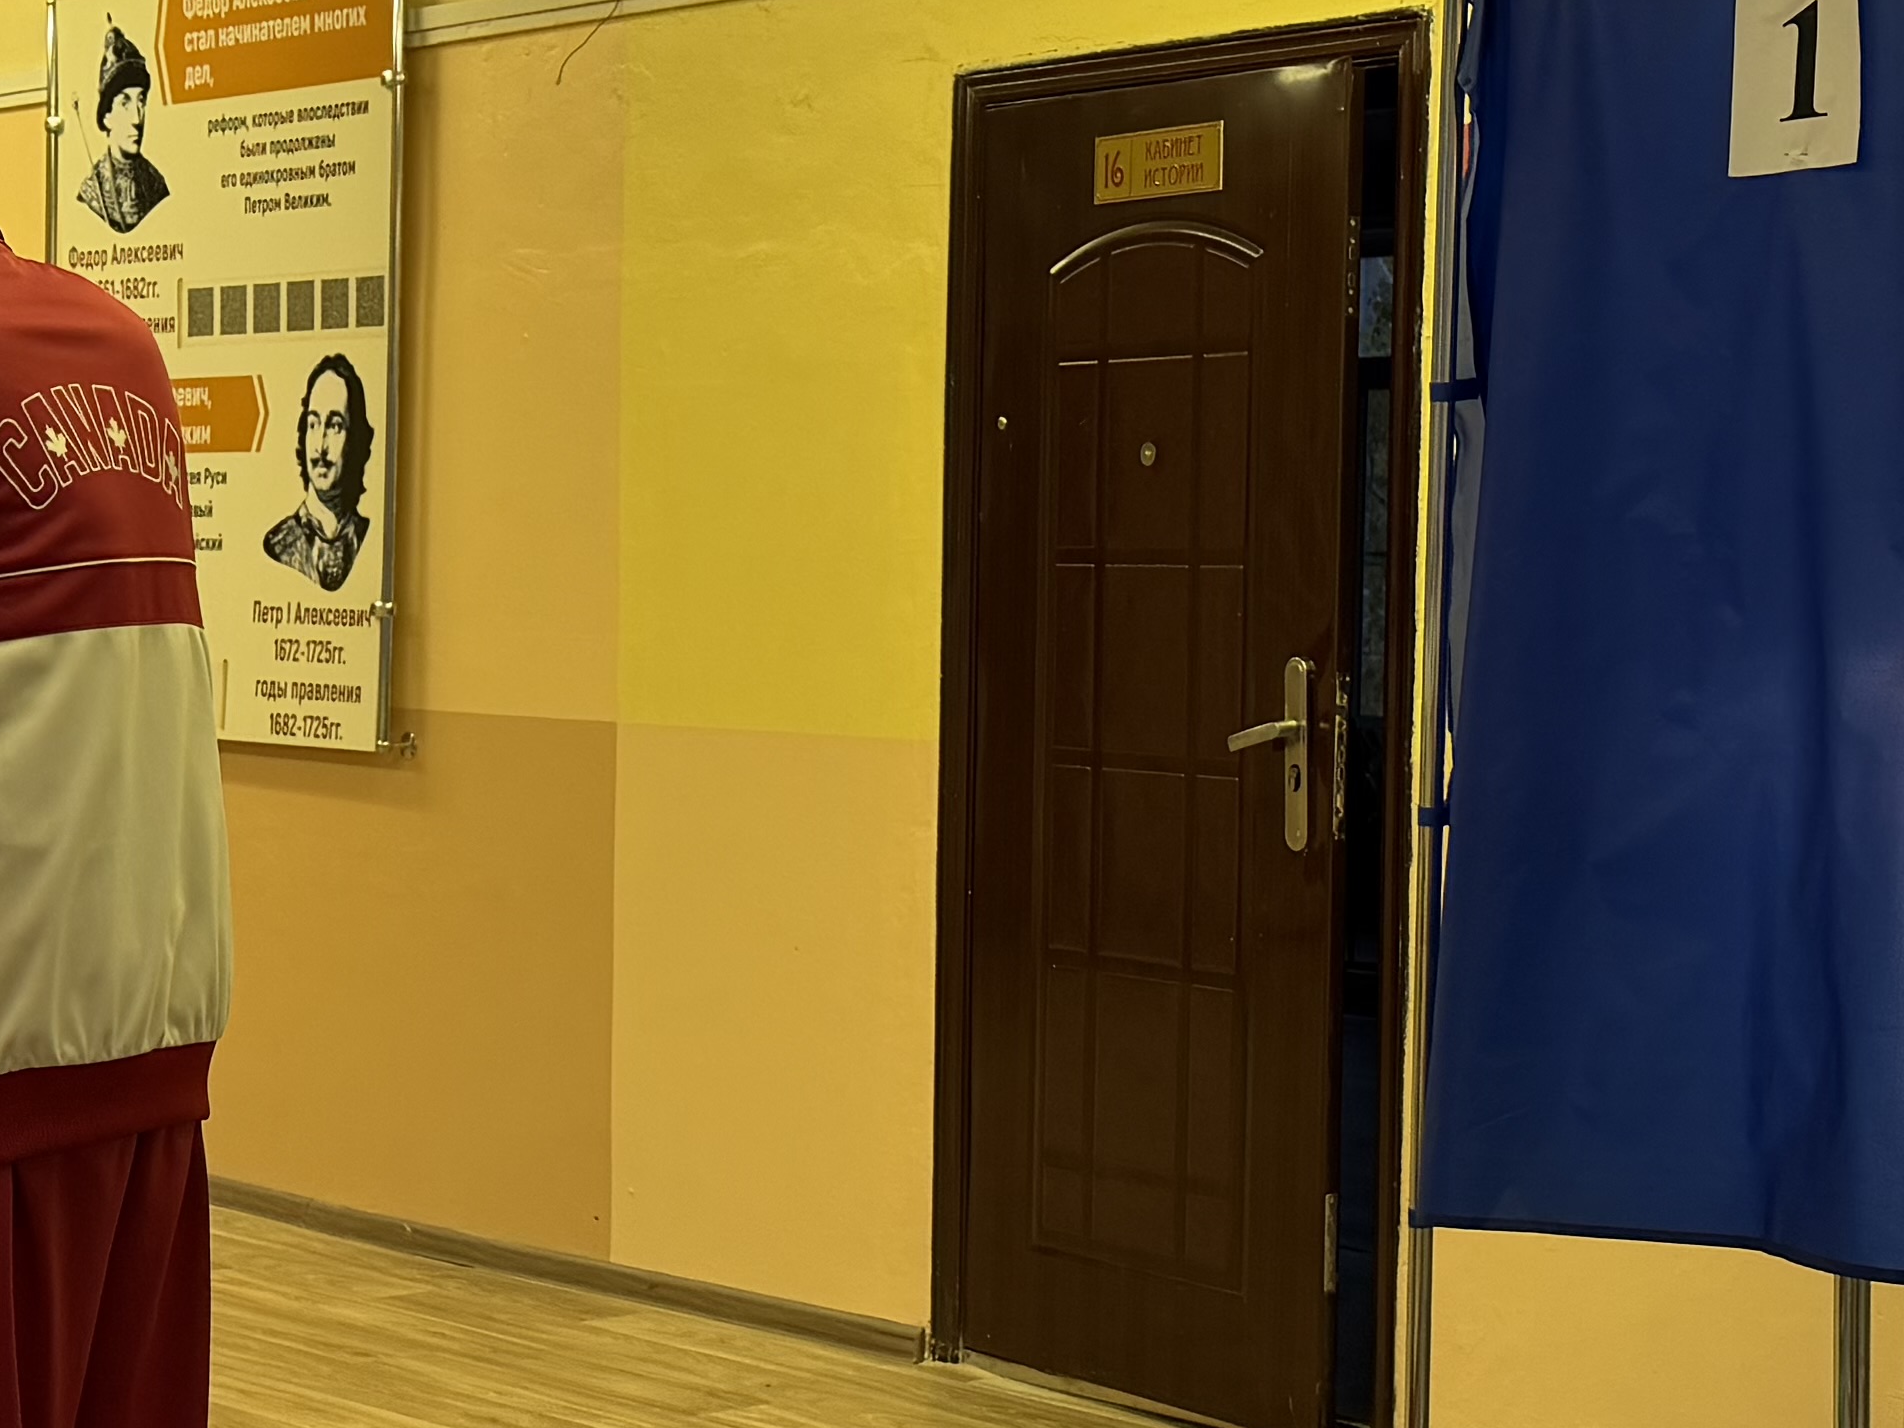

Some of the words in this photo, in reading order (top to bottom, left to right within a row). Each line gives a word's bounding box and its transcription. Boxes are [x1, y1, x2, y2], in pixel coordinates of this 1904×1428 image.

[184, 30, 215, 53] стал
[219, 13, 311, 46] начинателем
[314, 5, 367, 33] многих
[1779, 0, 1828, 122] 1
[184, 63, 214, 91] дел,
[252, 108, 294, 131] которые
[297, 100, 369, 122] впоследствии
[240, 139, 267, 158] были
[1145, 134, 1203, 162] КАБИНЕТ
[221, 173, 237, 189] его
[240, 164, 316, 188] единокровным
[319, 159, 356, 182] братом
[1104, 150, 1124, 189] 16
[1144, 162, 1204, 189] ИСТОРИИ
[245, 196, 281, 217] Петром
[68, 246, 108, 271] Федор
[111, 243, 184, 265] Алексеевич
[172, 386, 212, 410] евич,
[203, 468, 227, 489] Руси
[253, 600, 283, 629] Петр
[294, 601, 372, 627] Алексеевич
[274, 638, 346, 664] 1672-1725гг.
[255, 679, 288, 702] годы
[291, 681, 362, 706] правления
[269, 713, 343, 740] 1682-1725гг.
